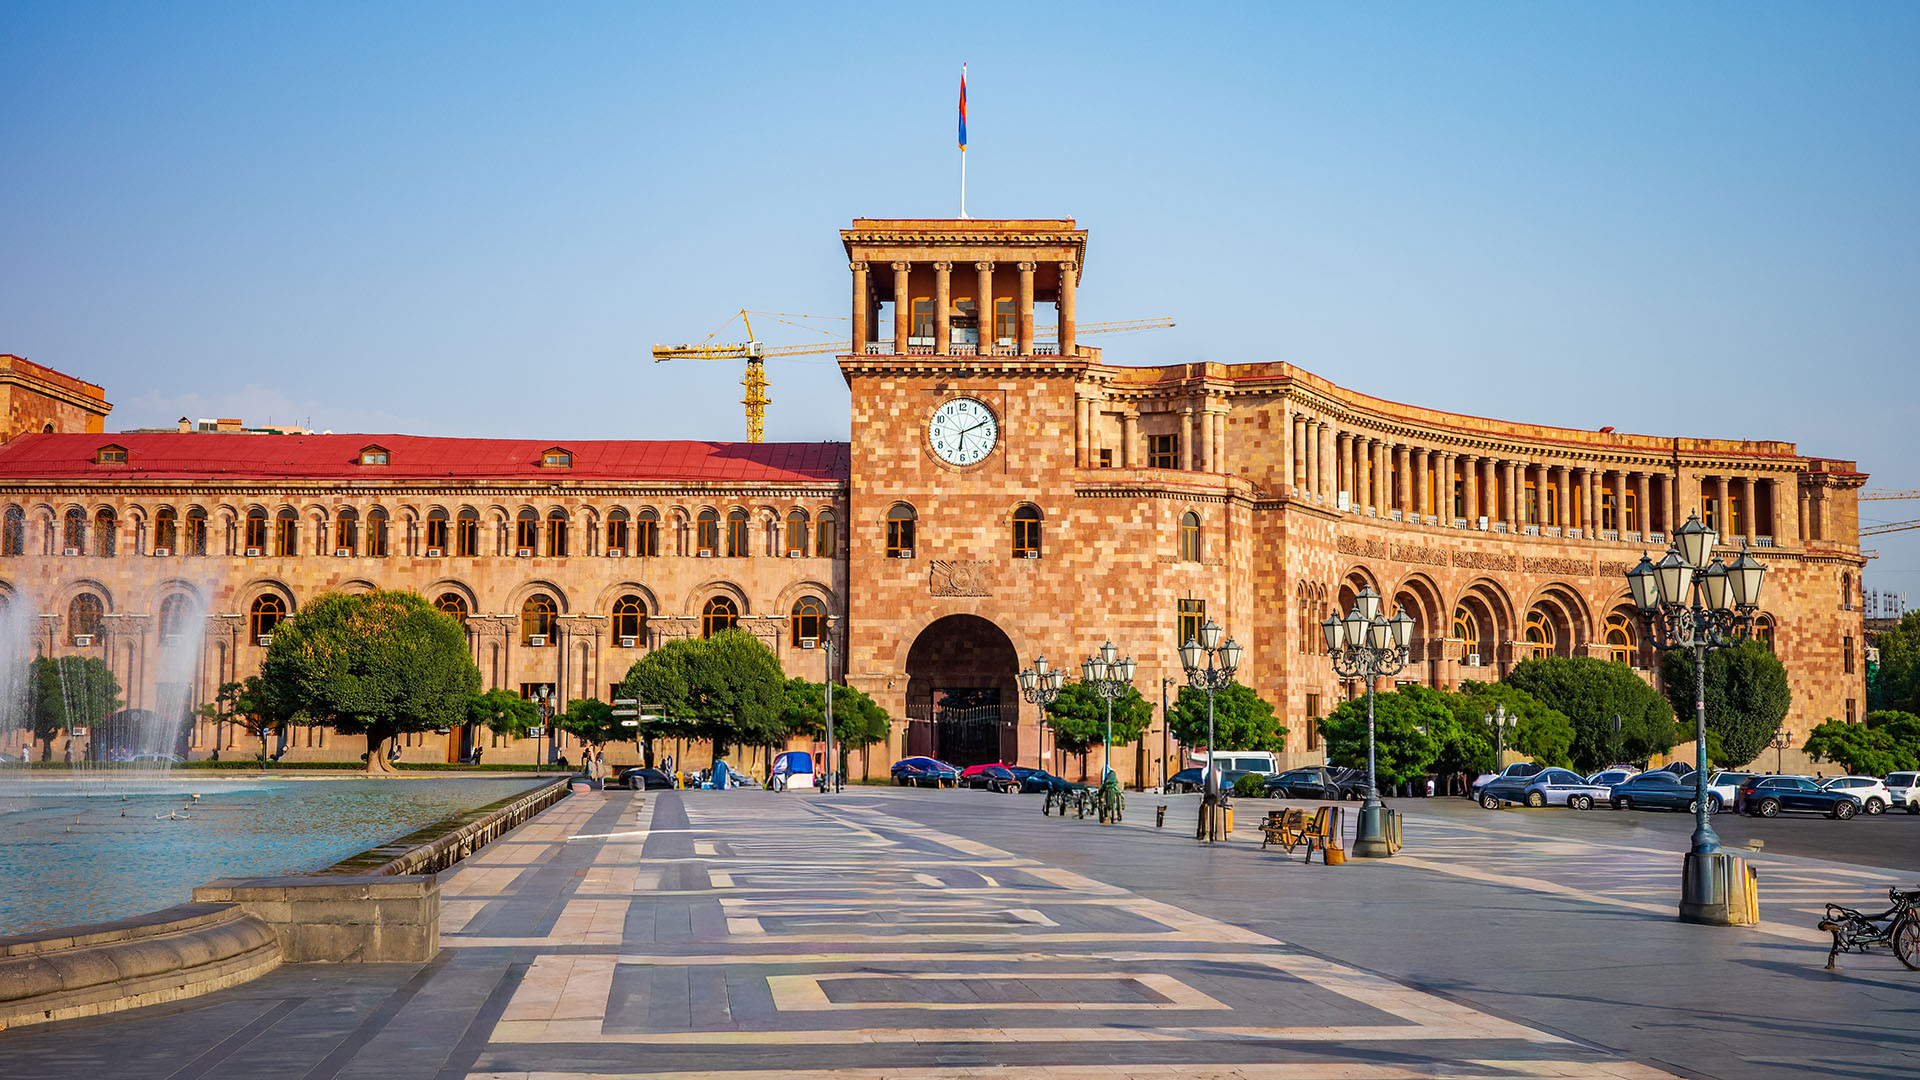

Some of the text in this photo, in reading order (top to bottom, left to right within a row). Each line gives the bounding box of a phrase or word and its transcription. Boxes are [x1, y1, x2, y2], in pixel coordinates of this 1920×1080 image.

[947, 406, 953, 414] 11
[959, 403, 967, 411] 12
[974, 406, 977, 414] 1
[937, 416, 944, 424] 10
[934, 428, 940, 436] 9
[986, 428, 991, 436] 3
